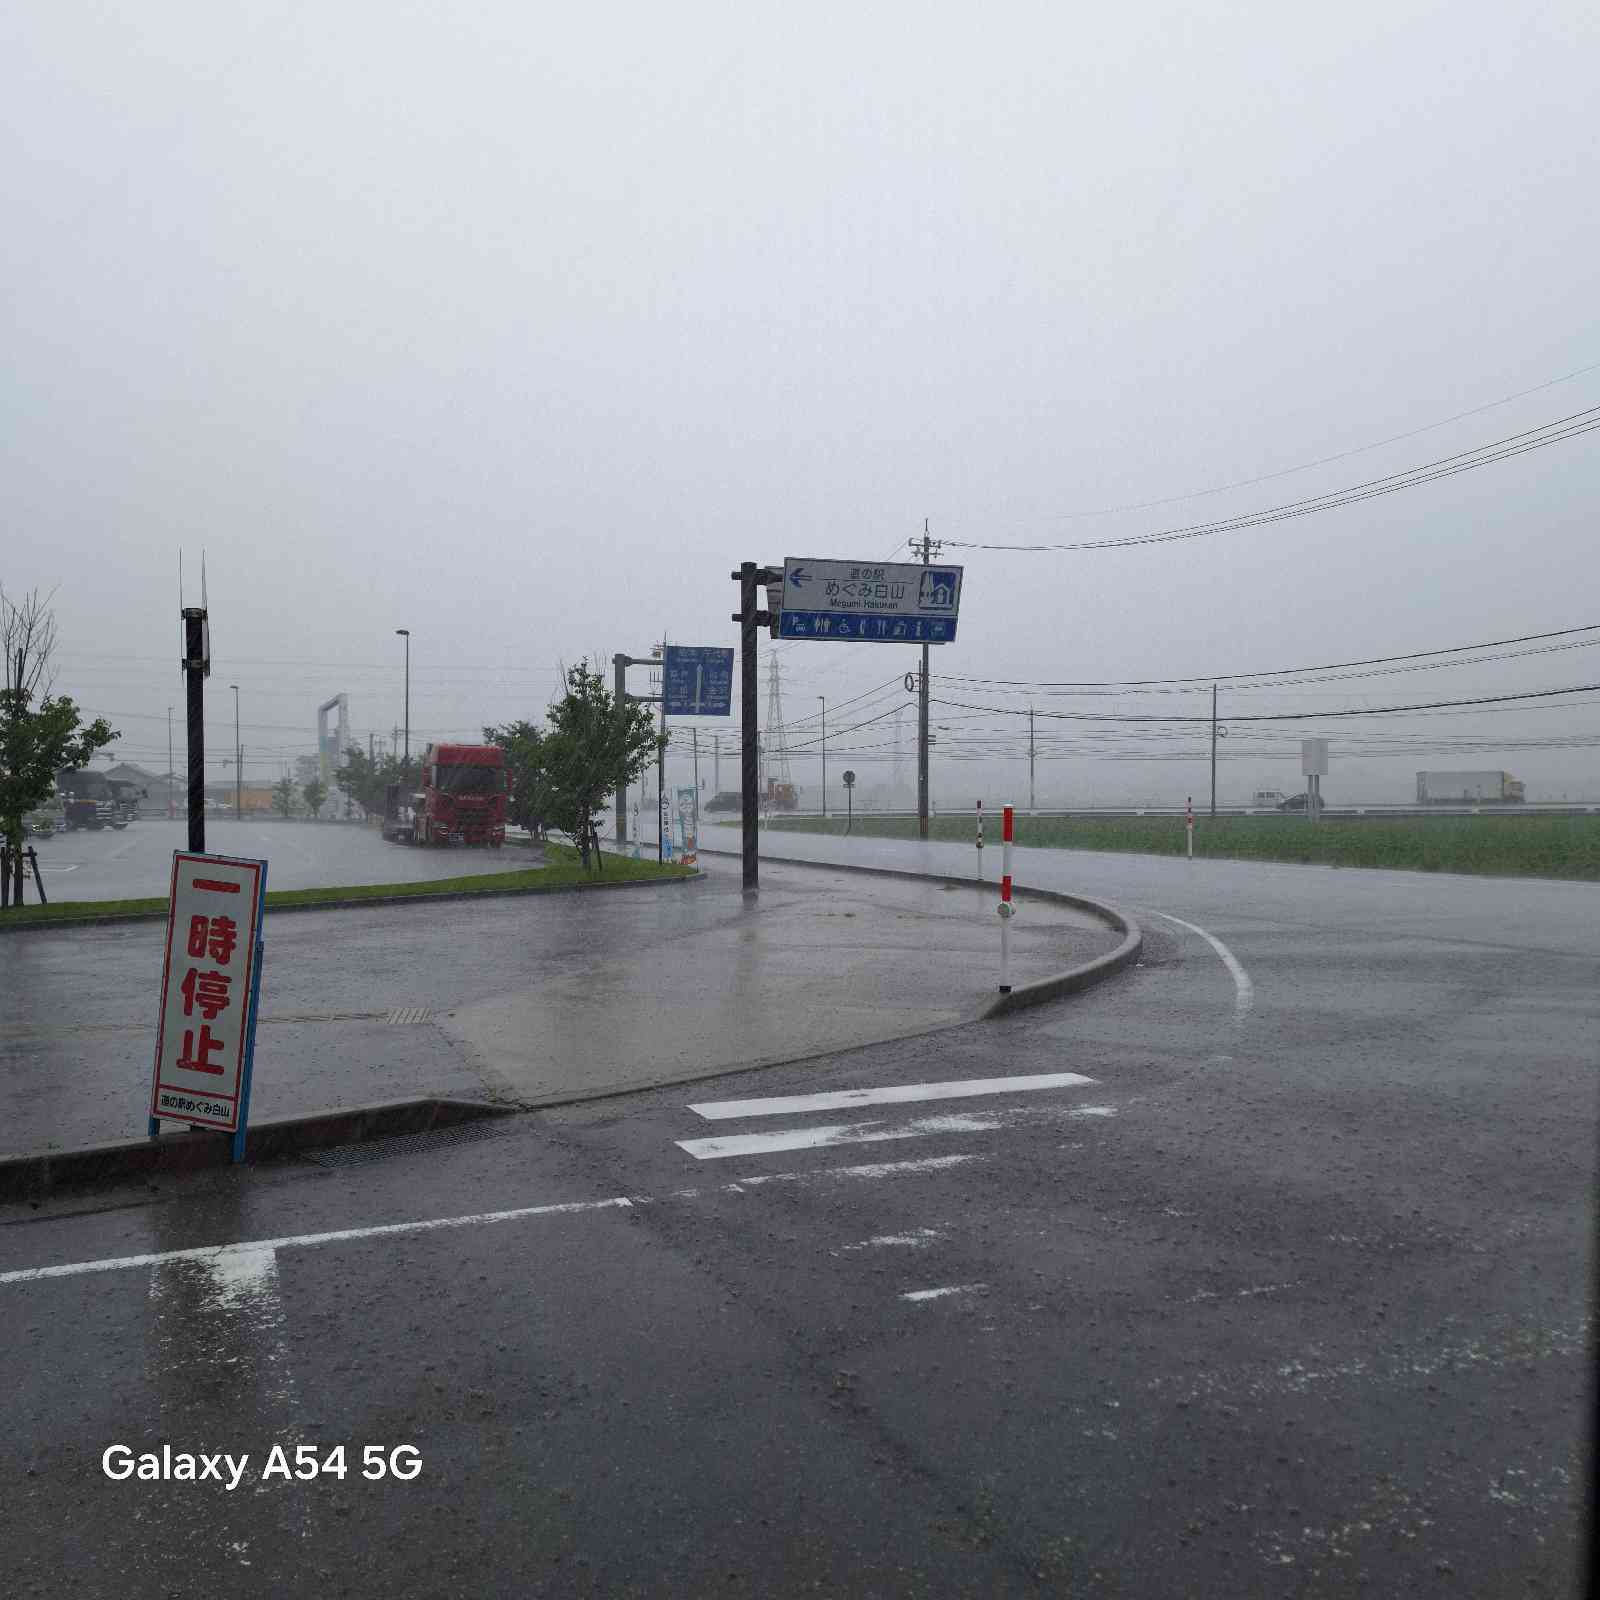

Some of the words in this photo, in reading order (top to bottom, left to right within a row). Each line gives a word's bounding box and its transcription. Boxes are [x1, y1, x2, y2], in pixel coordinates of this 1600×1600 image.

[850, 568, 885, 580] 道の駅
[825, 582, 904, 600] めぐみ白山
[176, 878, 241, 1076] 一時停止
[161, 1094, 230, 1117] 道の駅めぐみ白山
